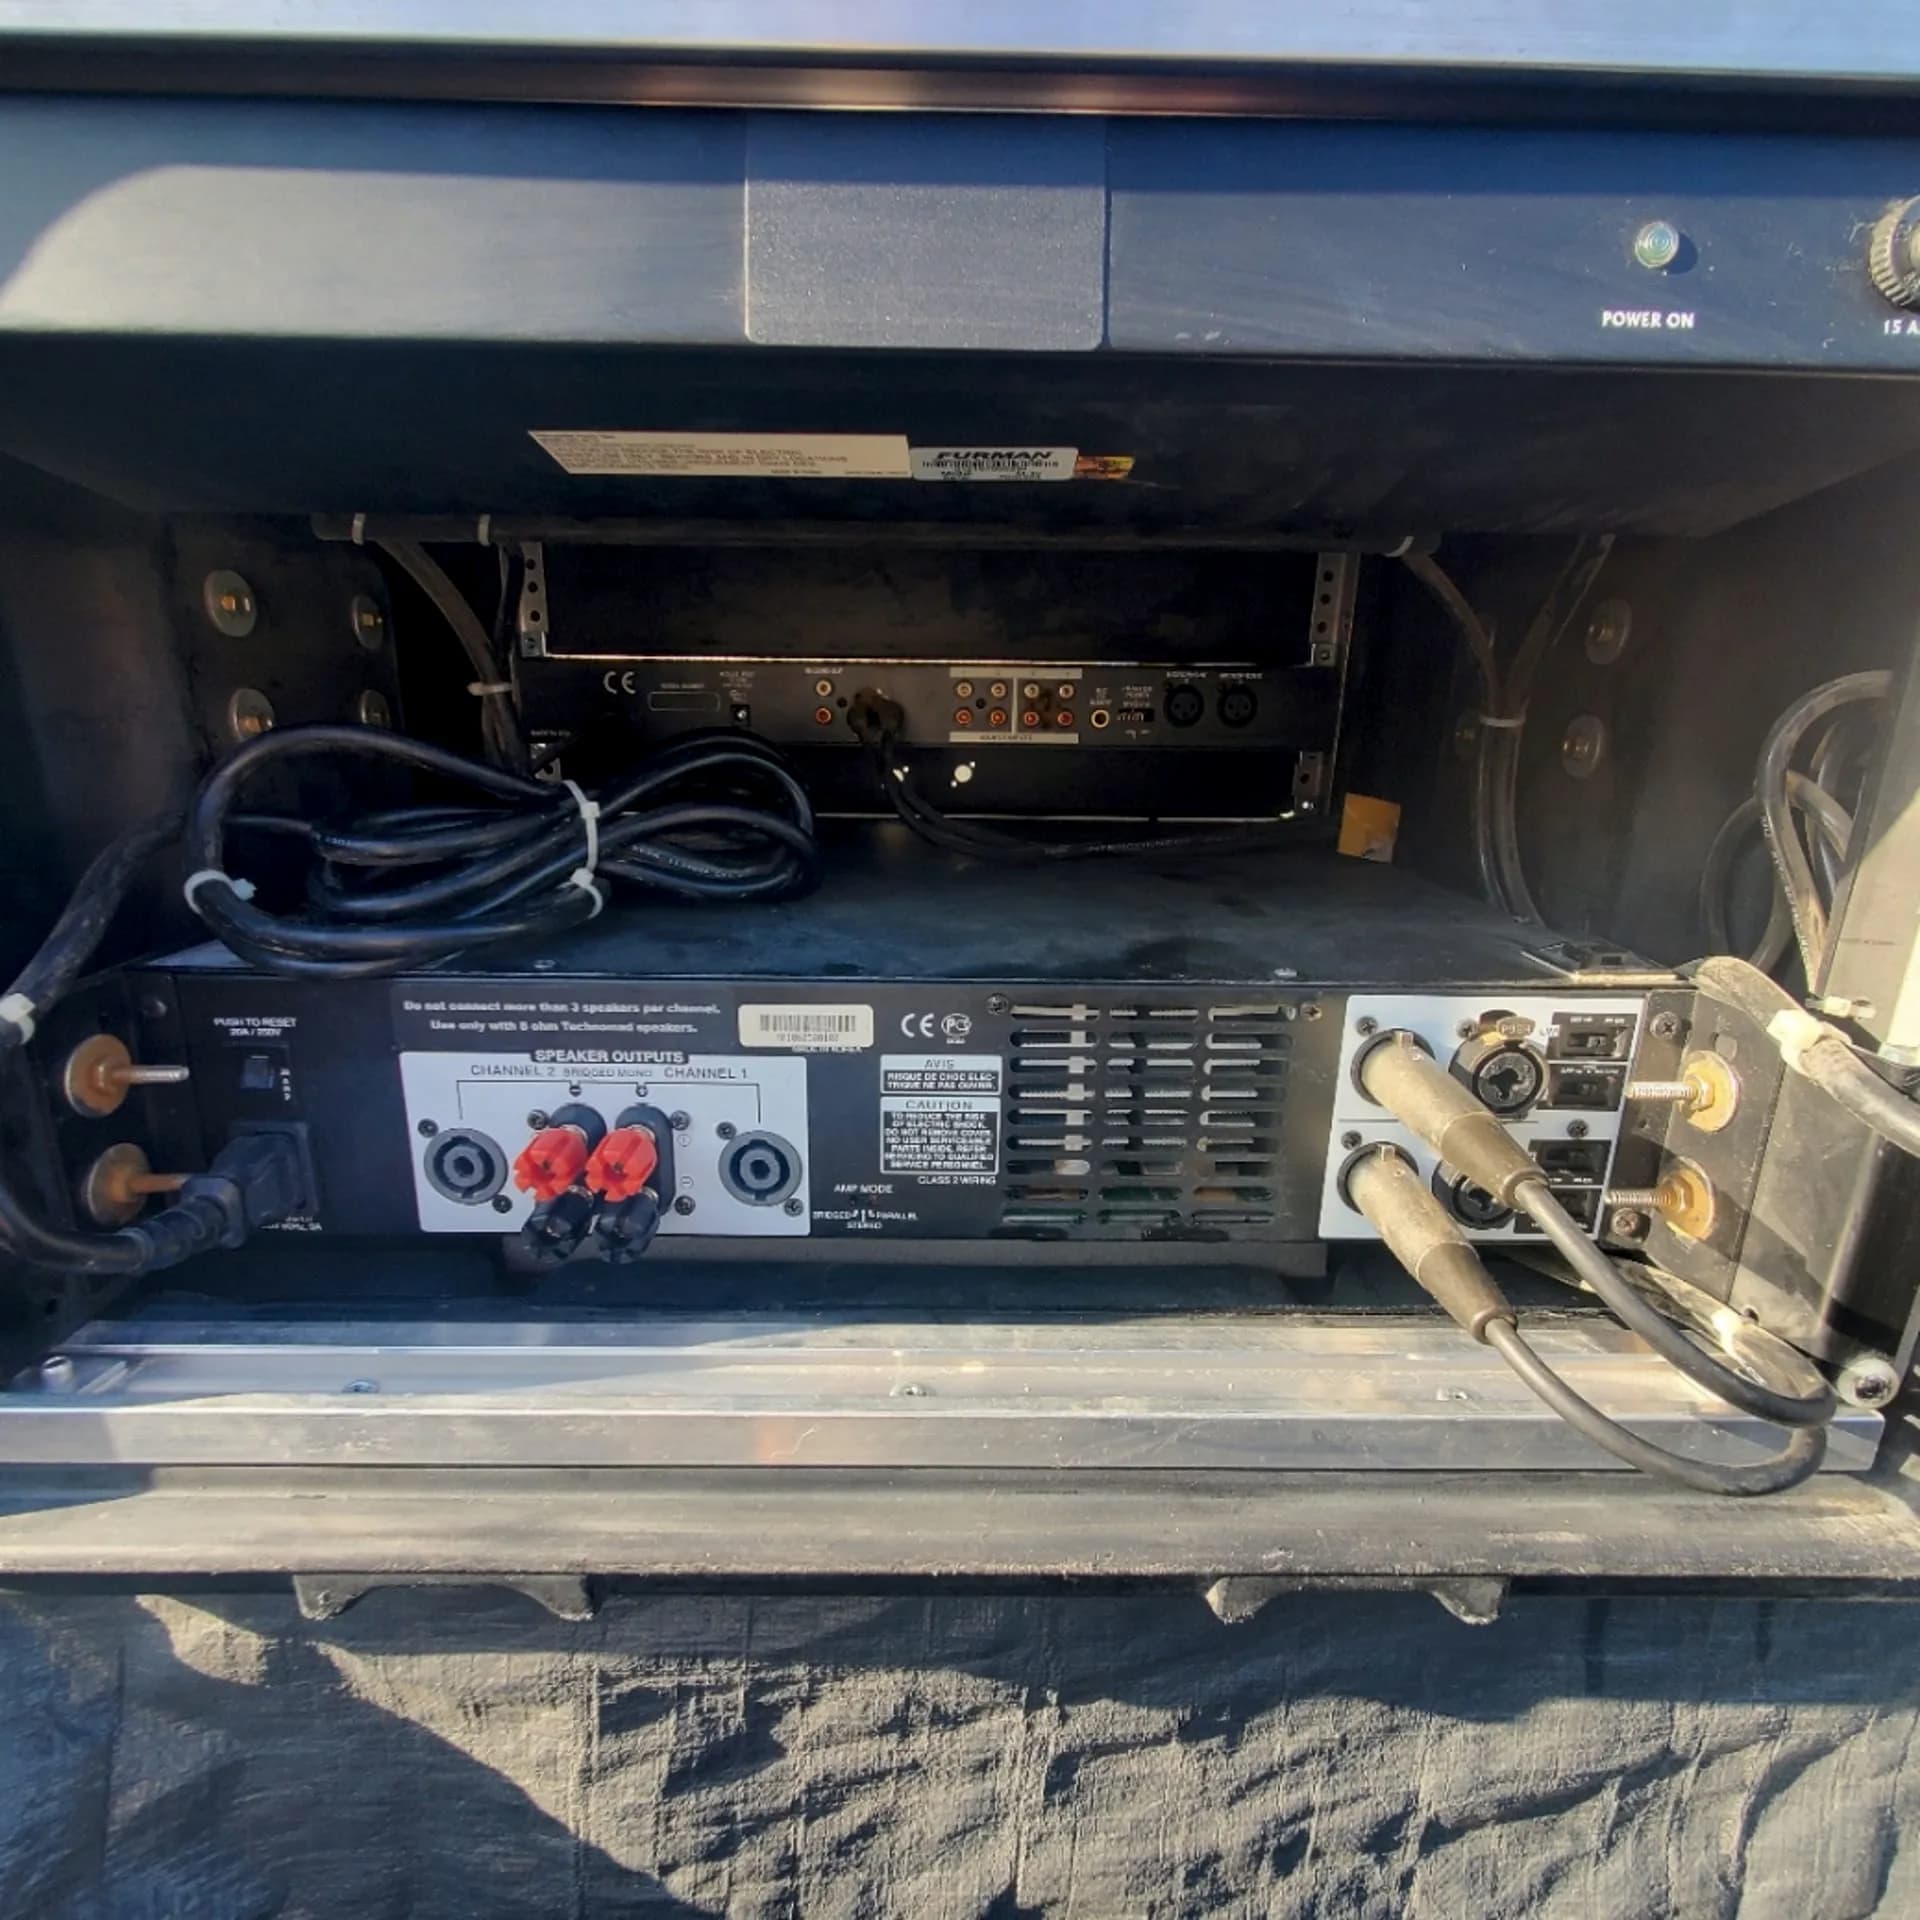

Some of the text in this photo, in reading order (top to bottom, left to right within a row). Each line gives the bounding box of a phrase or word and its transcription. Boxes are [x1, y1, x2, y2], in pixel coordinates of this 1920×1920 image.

[1602, 311, 1695, 328] POWER ON
[1884, 320, 1901, 335] 15
[937, 451, 1053, 460] FURMAN
[404, 1001, 422, 1011] Do
[424, 1002, 446, 1011] not
[449, 1002, 500, 1011] connect
[504, 1003, 536, 1011] more
[539, 1002, 569, 1012] than
[582, 1004, 639, 1014] speakers
[642, 1005, 663, 1014] per
[666, 1004, 720, 1014] channel.
[245, 1018, 261, 1027] TO
[262, 1018, 297, 1027] RESET
[430, 1021, 455, 1030] Use
[459, 1021, 486, 1033] only
[489, 1021, 517, 1031] with
[530, 1022, 559, 1031] ohm
[561, 1022, 635, 1032] Technomad
[901, 1013, 935, 1037] CE
[535, 1050, 683, 1064] SPEAKER OUTPUTS
[924, 1059, 954, 1069] AVIS
[471, 1065, 556, 1076] CHANNEL 2
[563, 1068, 652, 1077] BRIDGED MONO
[664, 1067, 748, 1079] CHANNEL 1
[887, 1073, 922, 1081] RISQUE
[924, 1073, 936, 1081] DE
[939, 1073, 966, 1081] CHOC
[906, 1100, 972, 1110] CAUTION
[901, 1128, 919, 1136] NOT
[917, 1176, 951, 1184] CLASS
[959, 1176, 996, 1185] WIRING
[834, 1185, 894, 1193] AMP MODE
[847, 1222, 882, 1230] STEREO
